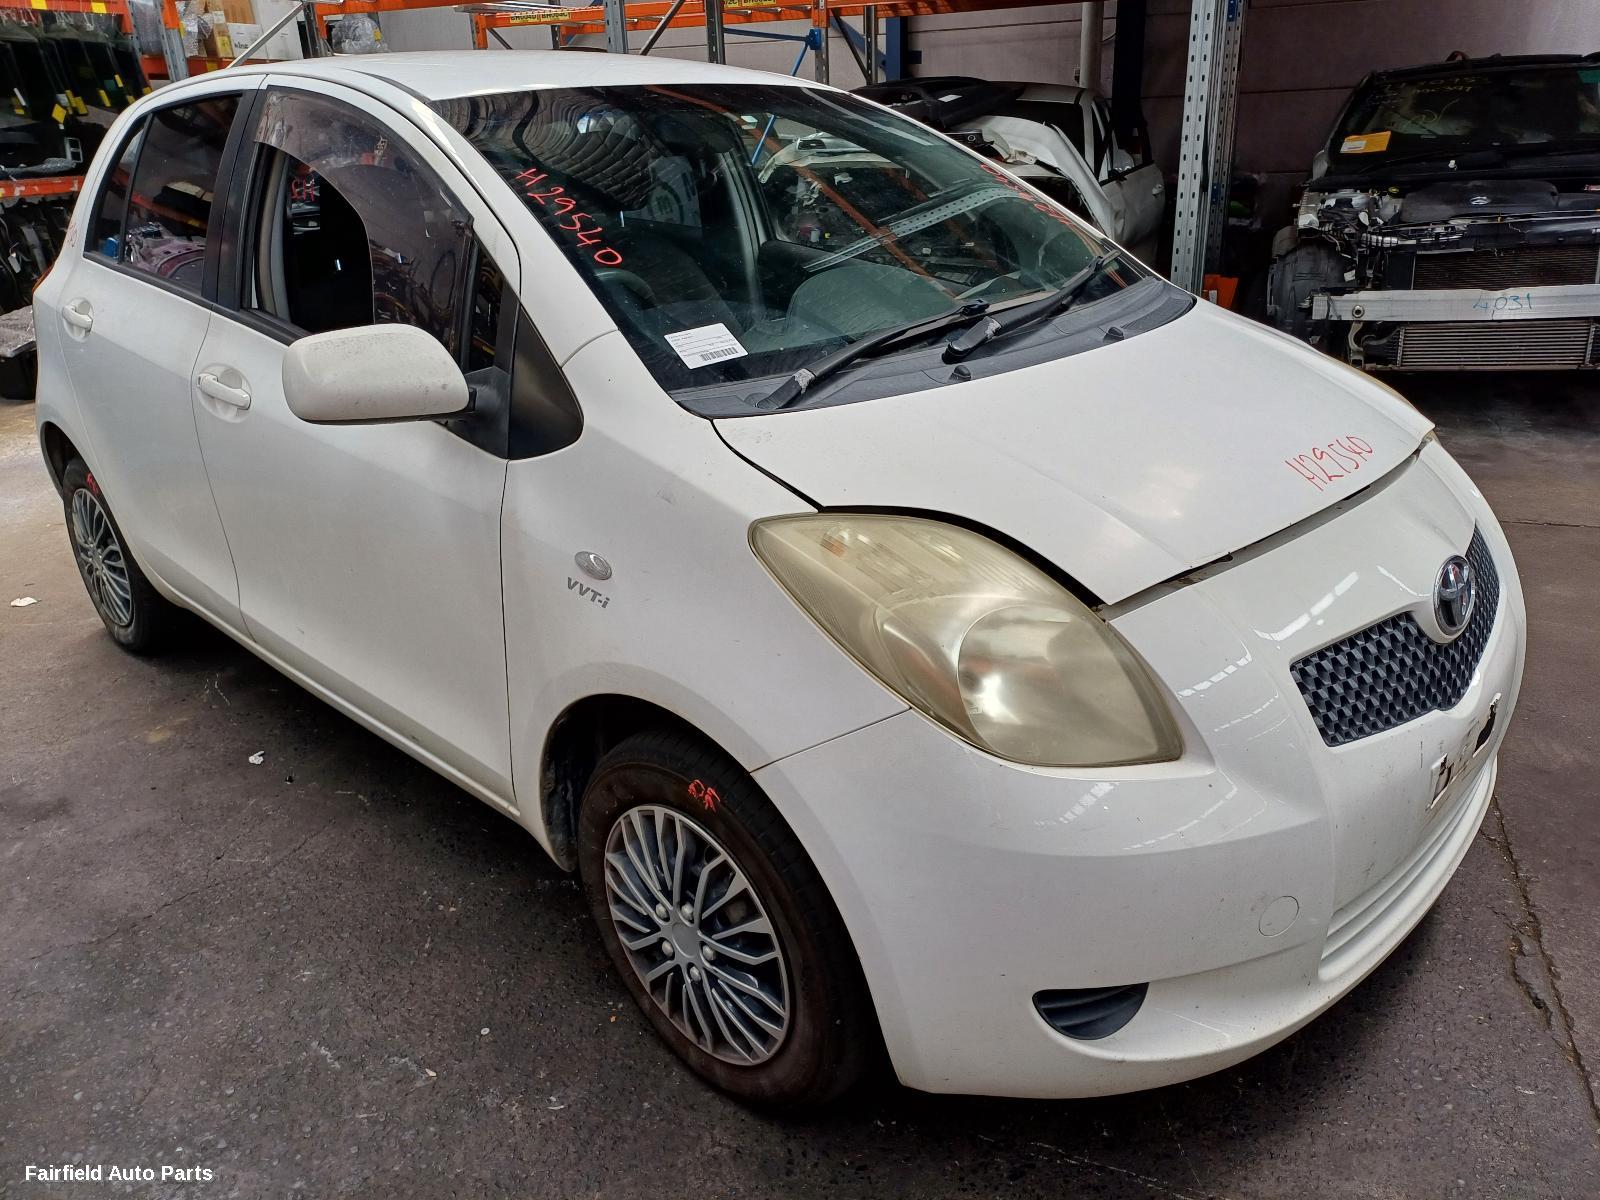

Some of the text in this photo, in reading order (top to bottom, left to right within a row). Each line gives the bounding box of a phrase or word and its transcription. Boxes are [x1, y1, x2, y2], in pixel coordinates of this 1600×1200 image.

[515, 168, 623, 265] H29540
[1285, 436, 1373, 491] H29540
[567, 577, 611, 608] VVT-i
